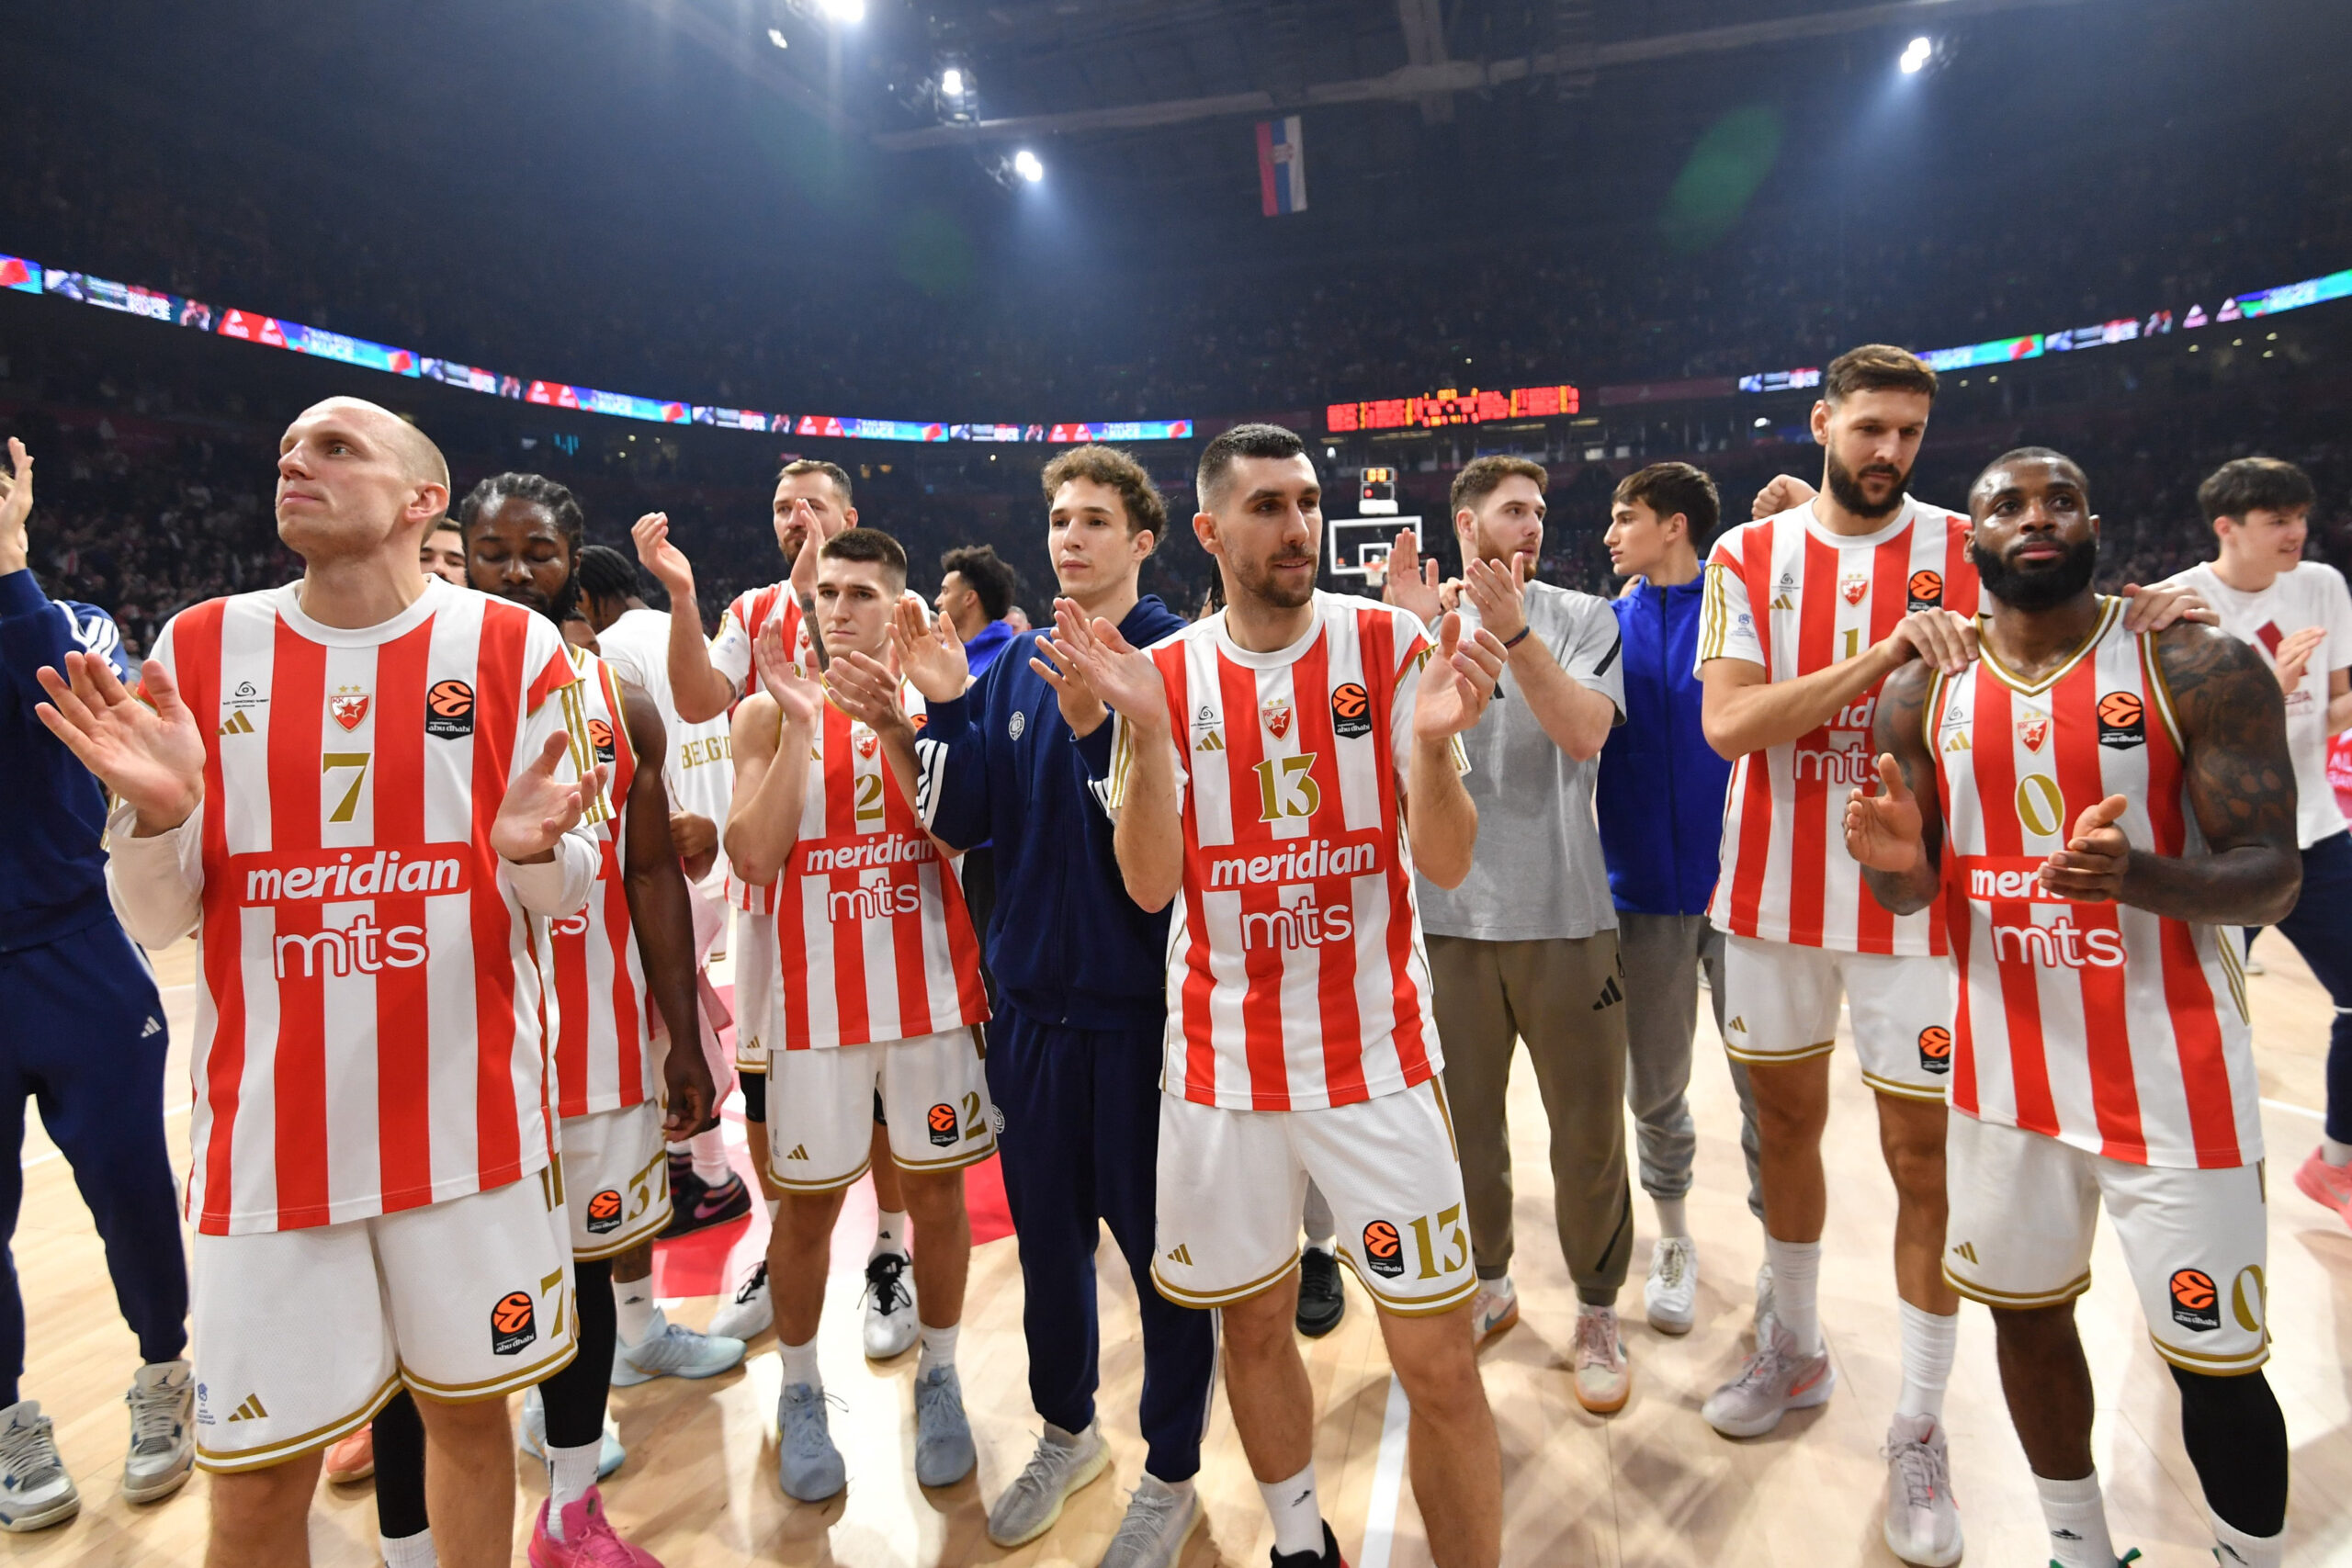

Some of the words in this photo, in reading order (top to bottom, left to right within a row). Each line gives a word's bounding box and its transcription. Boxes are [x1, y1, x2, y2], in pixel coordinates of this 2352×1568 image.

[446, 725, 471, 733] dhabi
[322, 752, 371, 823] 7
[855, 773, 884, 821] 2
[1251, 751, 1321, 823] 13
[2015, 773, 2065, 837] 0
[246, 851, 460, 901] meridian
[807, 833, 933, 872] meridian
[1210, 840, 1376, 886] meridian
[830, 879, 920, 921] mts
[1243, 897, 1352, 950] mts
[277, 917, 427, 978] mts
[1993, 919, 2124, 967] mts
[961, 1091, 988, 1141] 2
[1408, 1201, 1467, 1280] 13
[540, 1265, 564, 1339] 7
[2232, 1264, 2264, 1332] 0
